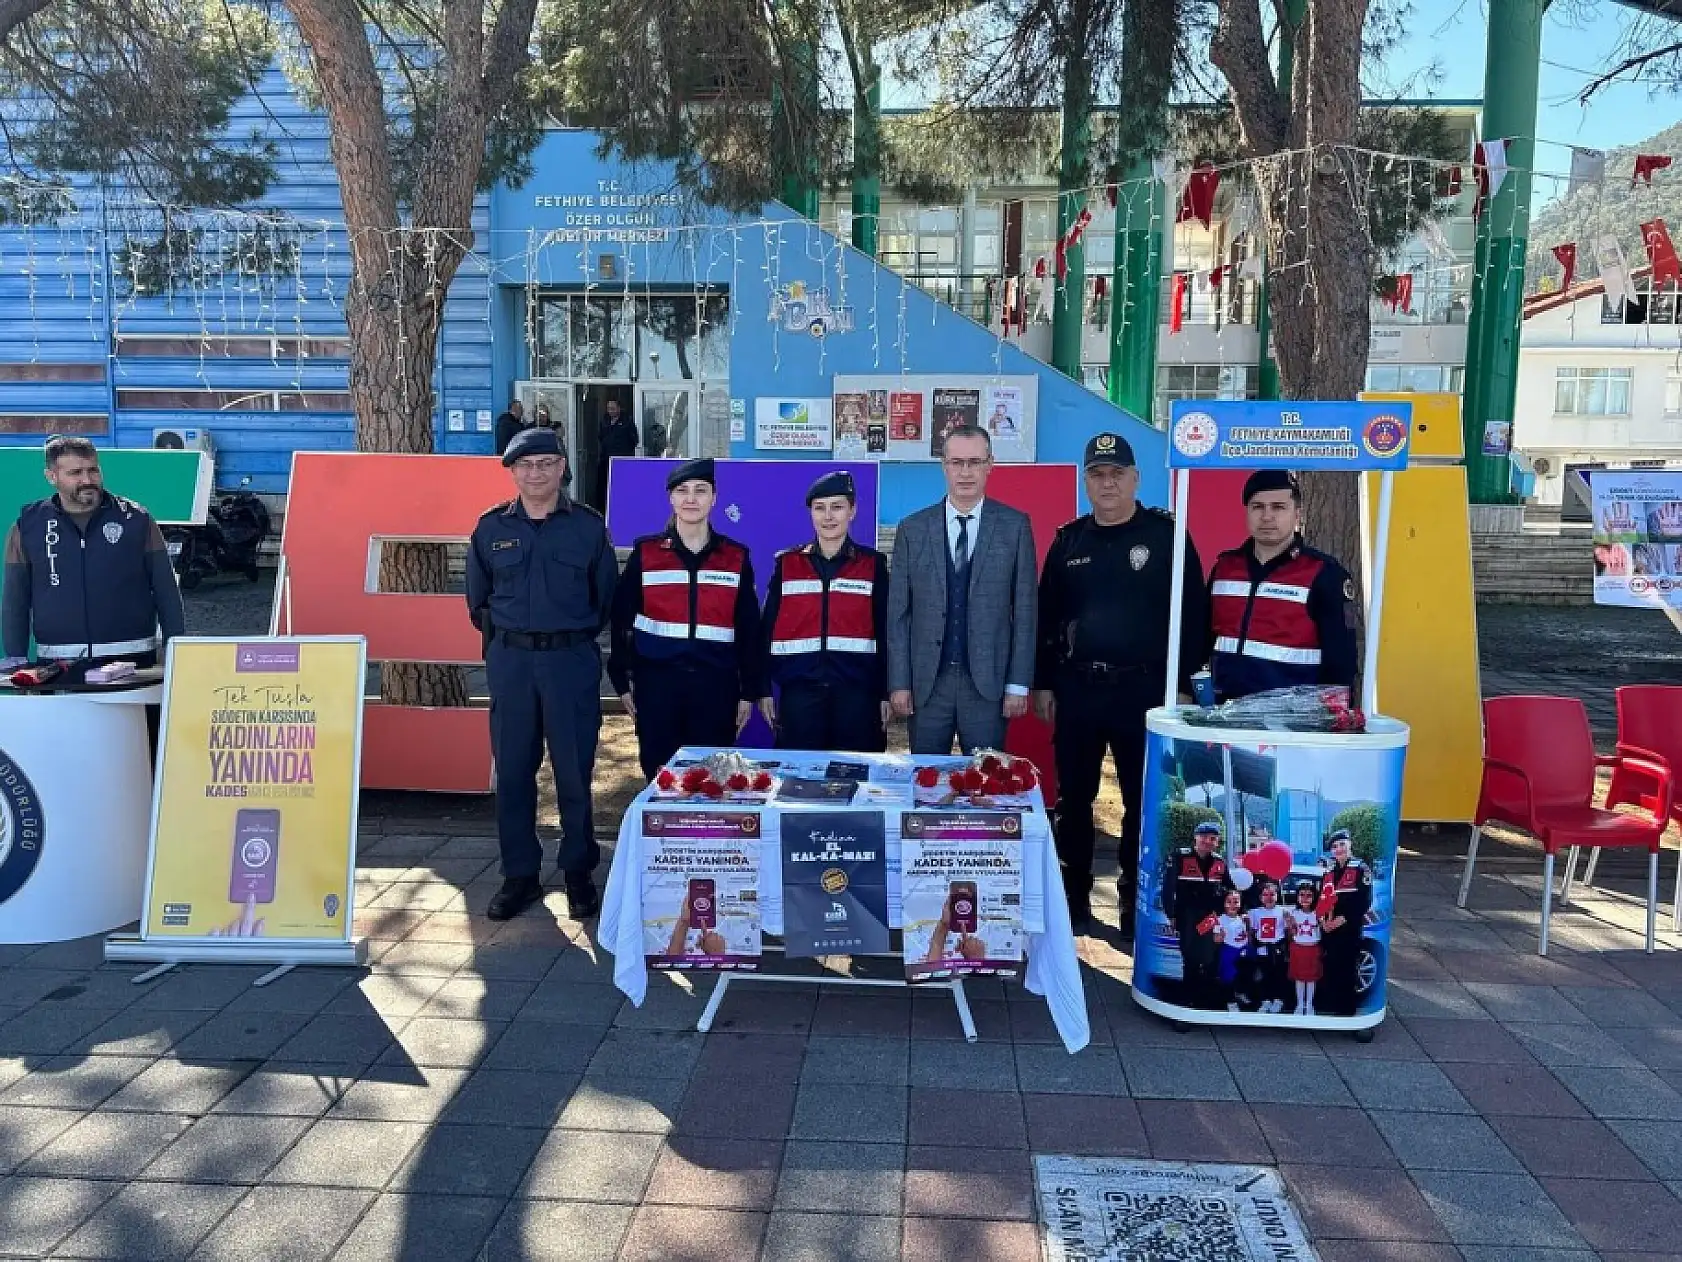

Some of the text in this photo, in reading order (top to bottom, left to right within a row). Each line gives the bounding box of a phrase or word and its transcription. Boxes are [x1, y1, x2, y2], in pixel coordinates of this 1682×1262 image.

[213, 684, 248, 709] Tek
[209, 725, 316, 750] KADINLARIN
[209, 751, 314, 784] YANINDA
[206, 785, 247, 798] KADES
[654, 855, 692, 865] KADES
[914, 858, 954, 868] KADES
